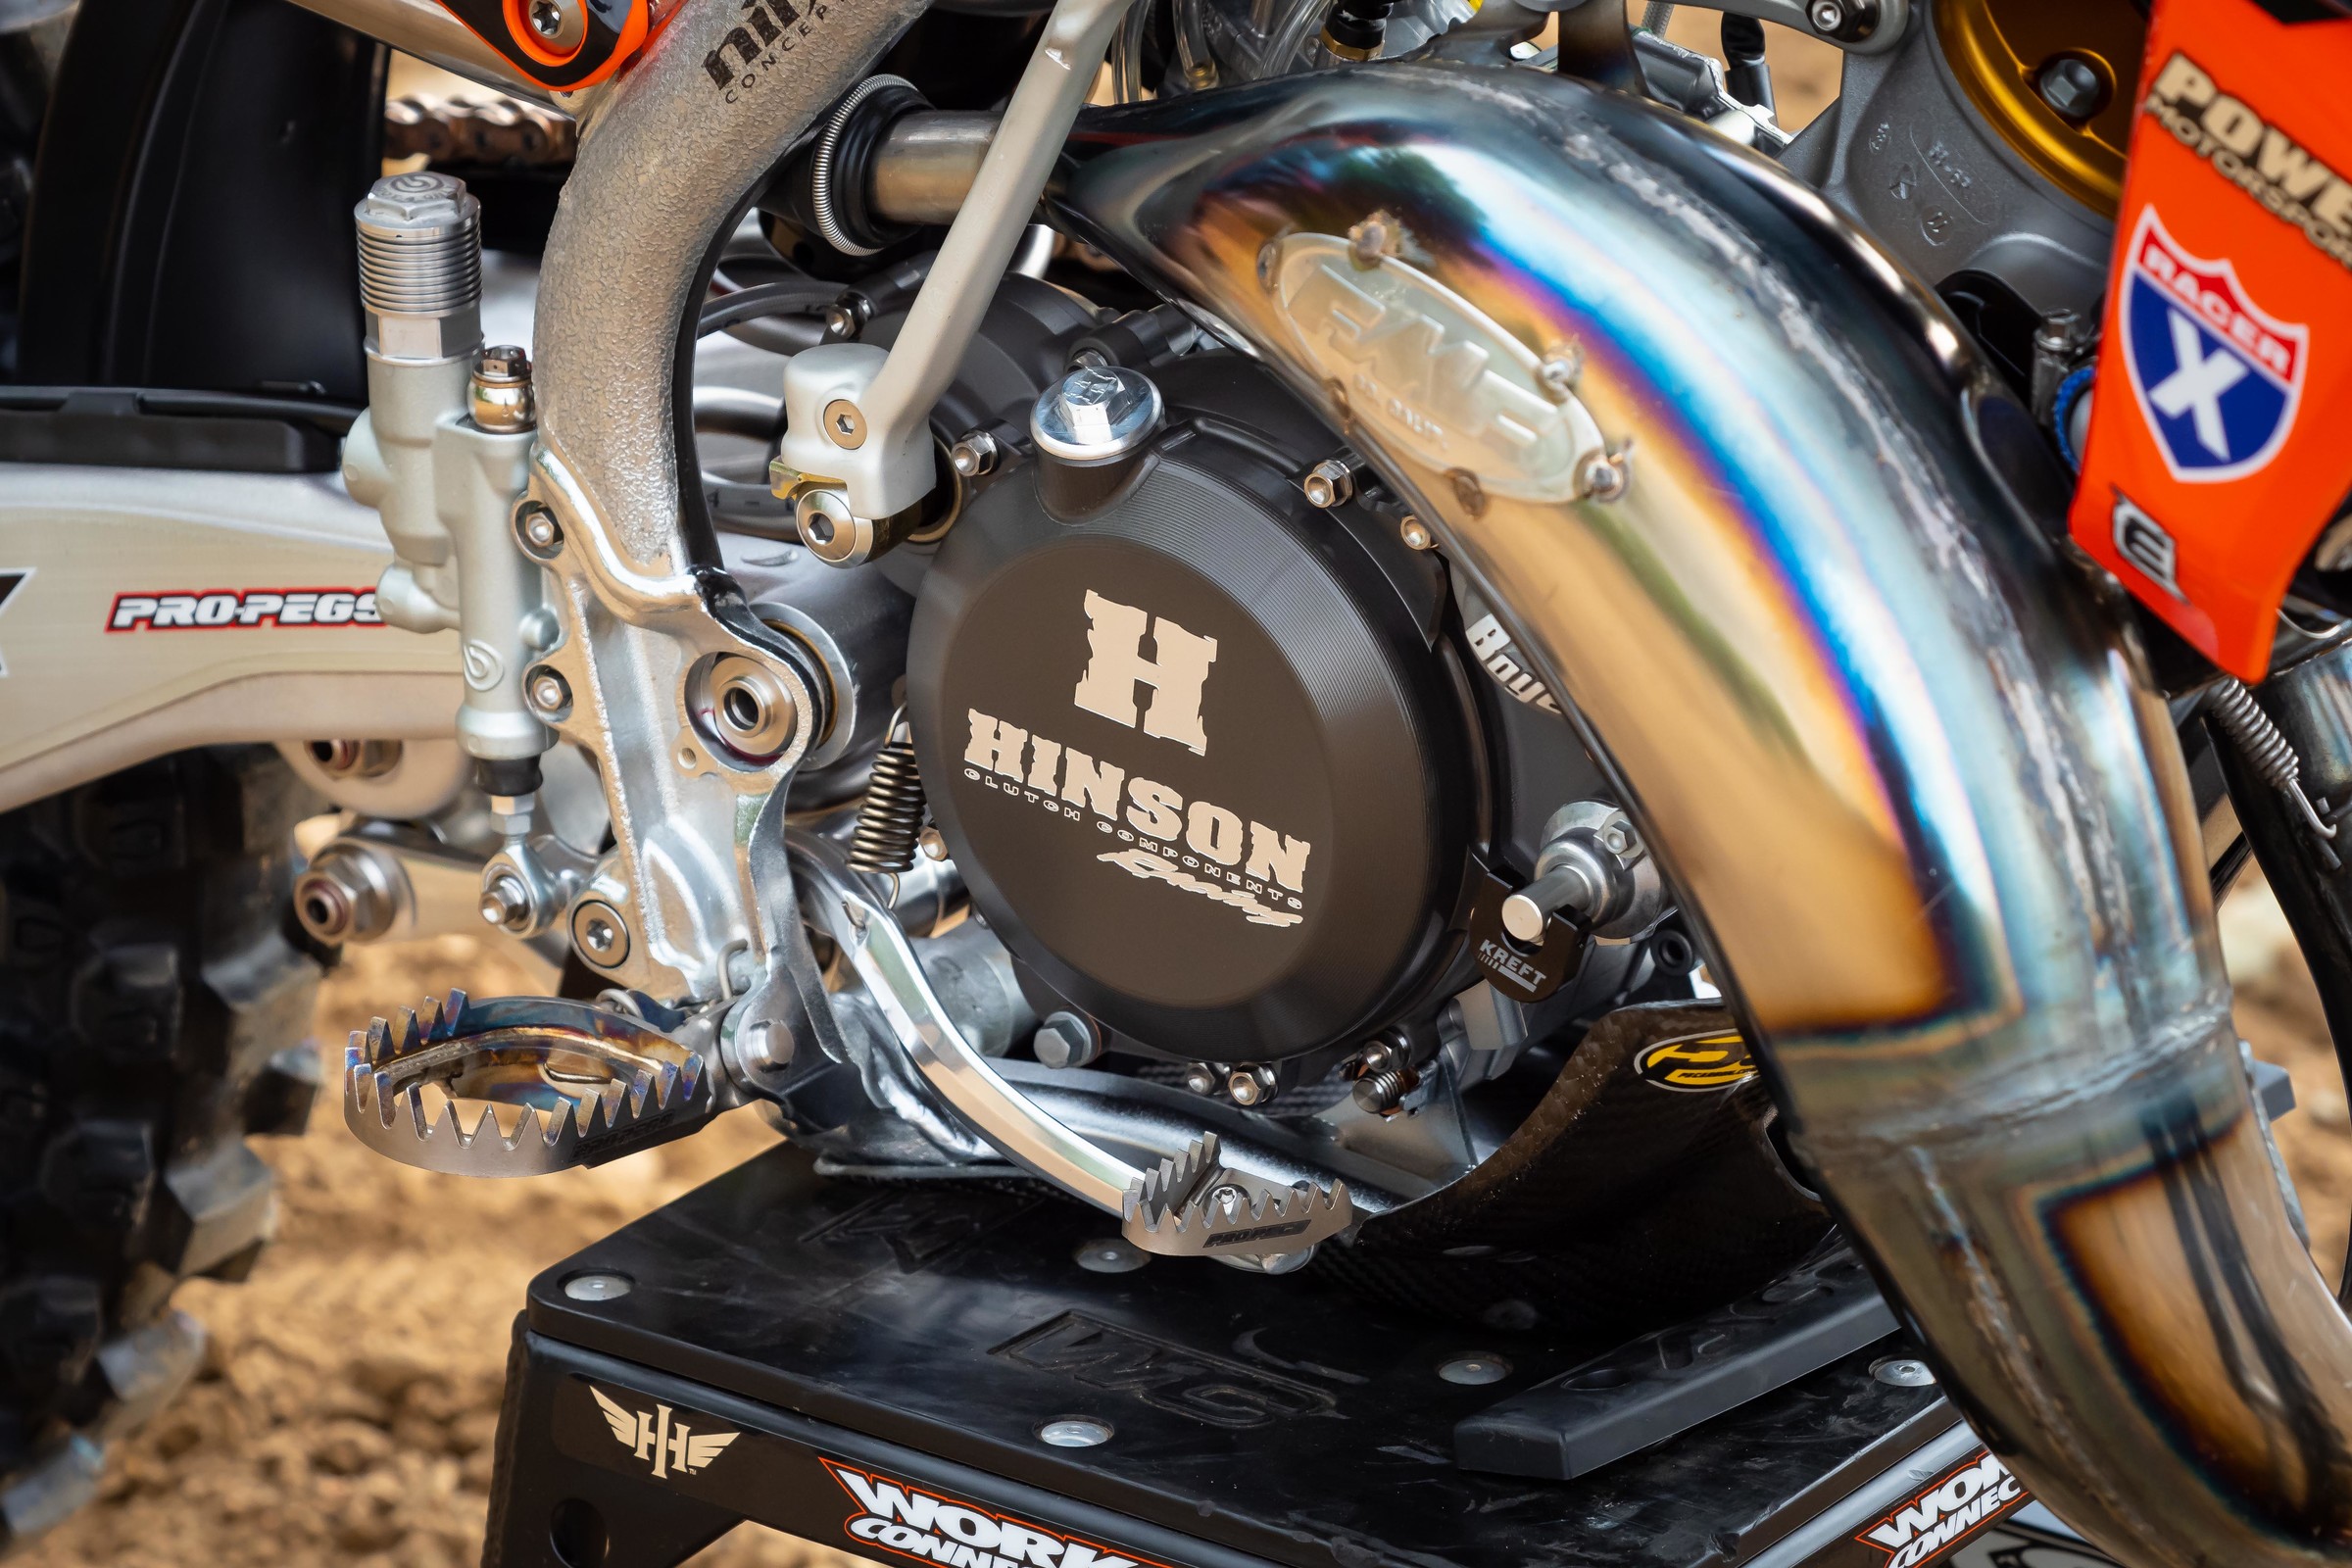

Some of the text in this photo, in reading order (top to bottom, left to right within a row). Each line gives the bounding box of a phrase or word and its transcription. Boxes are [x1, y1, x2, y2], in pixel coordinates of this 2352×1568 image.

[725, 0, 845, 104] CONCEP
[2143, 244, 2291, 374] RACER
[2149, 307, 2251, 463] X
[1075, 588, 1218, 757] H
[964, 708, 1311, 893] HINSON
[964, 767, 1303, 909] CLUTCH COMPONENTS
[1479, 939, 1547, 985] KREFT
[837, 1469, 1139, 1568] WORK
